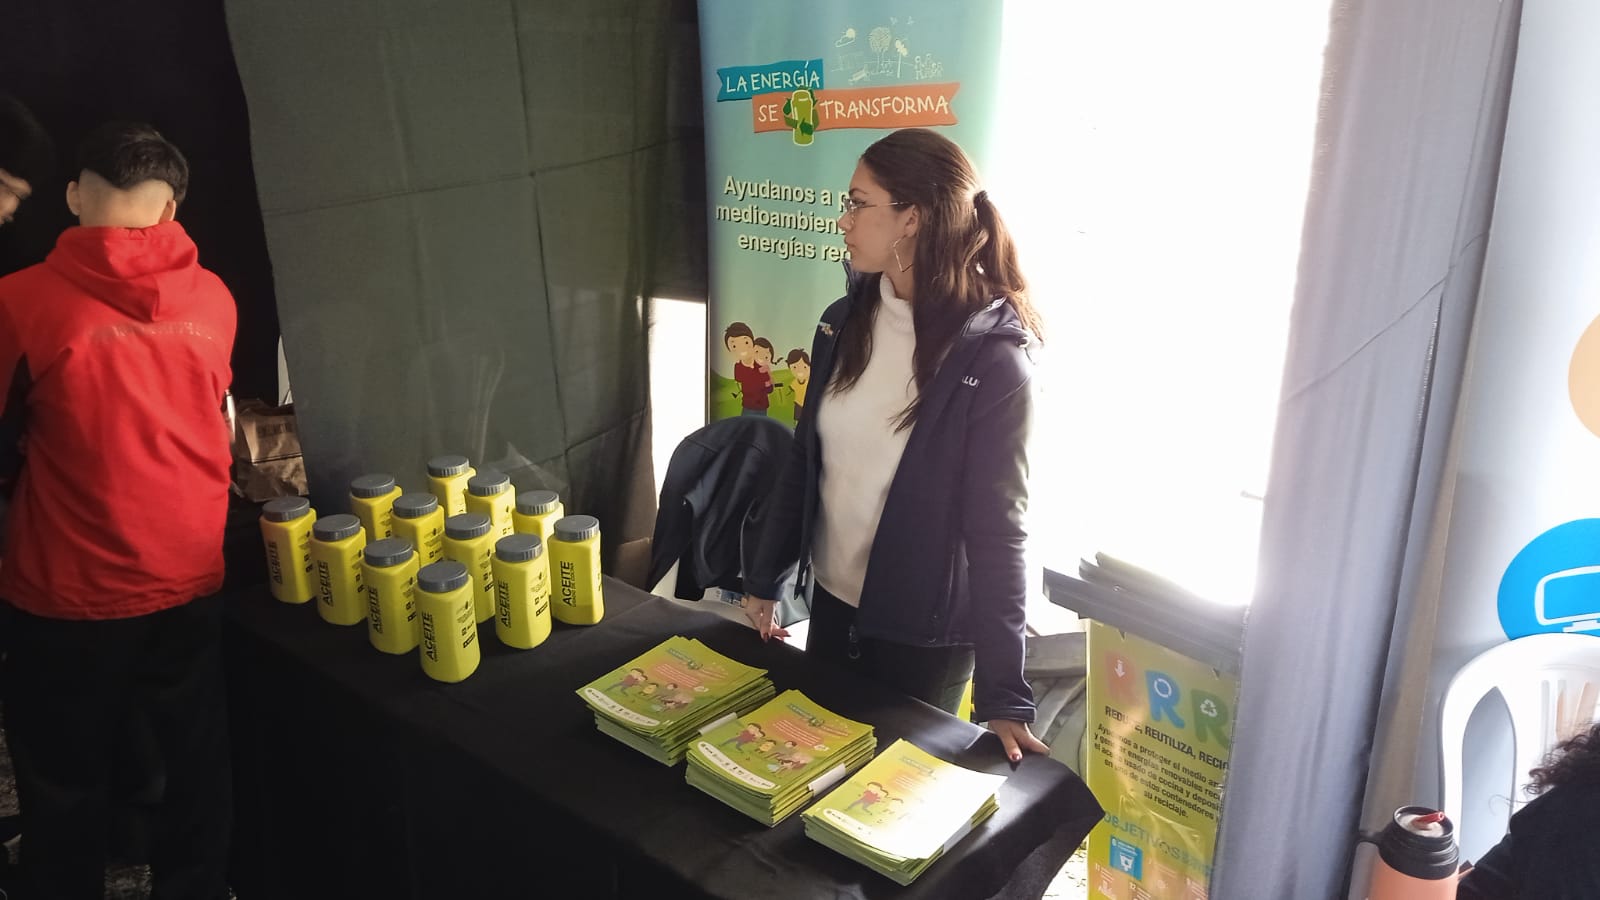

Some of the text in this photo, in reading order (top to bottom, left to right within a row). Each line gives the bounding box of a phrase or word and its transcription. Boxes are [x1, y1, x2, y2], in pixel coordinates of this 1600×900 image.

[726, 60, 820, 93] LA ENERGÍA
[758, 95, 949, 122] SE TRANSFORMA
[724, 175, 816, 204] Ayudanos
[821, 189, 833, 206] a
[738, 233, 852, 263] energías ren
[317, 560, 329, 606] ACEITE
[559, 560, 572, 607] ACEITE
[367, 585, 380, 633] ACEITE
[497, 580, 509, 628] ACEITE
[420, 611, 434, 661] ACEITE
[1145, 725, 1196, 759] REUTILIZA,
[1158, 776, 1184, 794] cocina
[1161, 767, 1203, 793] renovables
[1173, 762, 1180, 771] el
[1182, 766, 1207, 783] medio
[1104, 759, 1113, 768] en
[1161, 788, 1215, 820] contenedores
[1143, 790, 1189, 818] su reciclaje.
